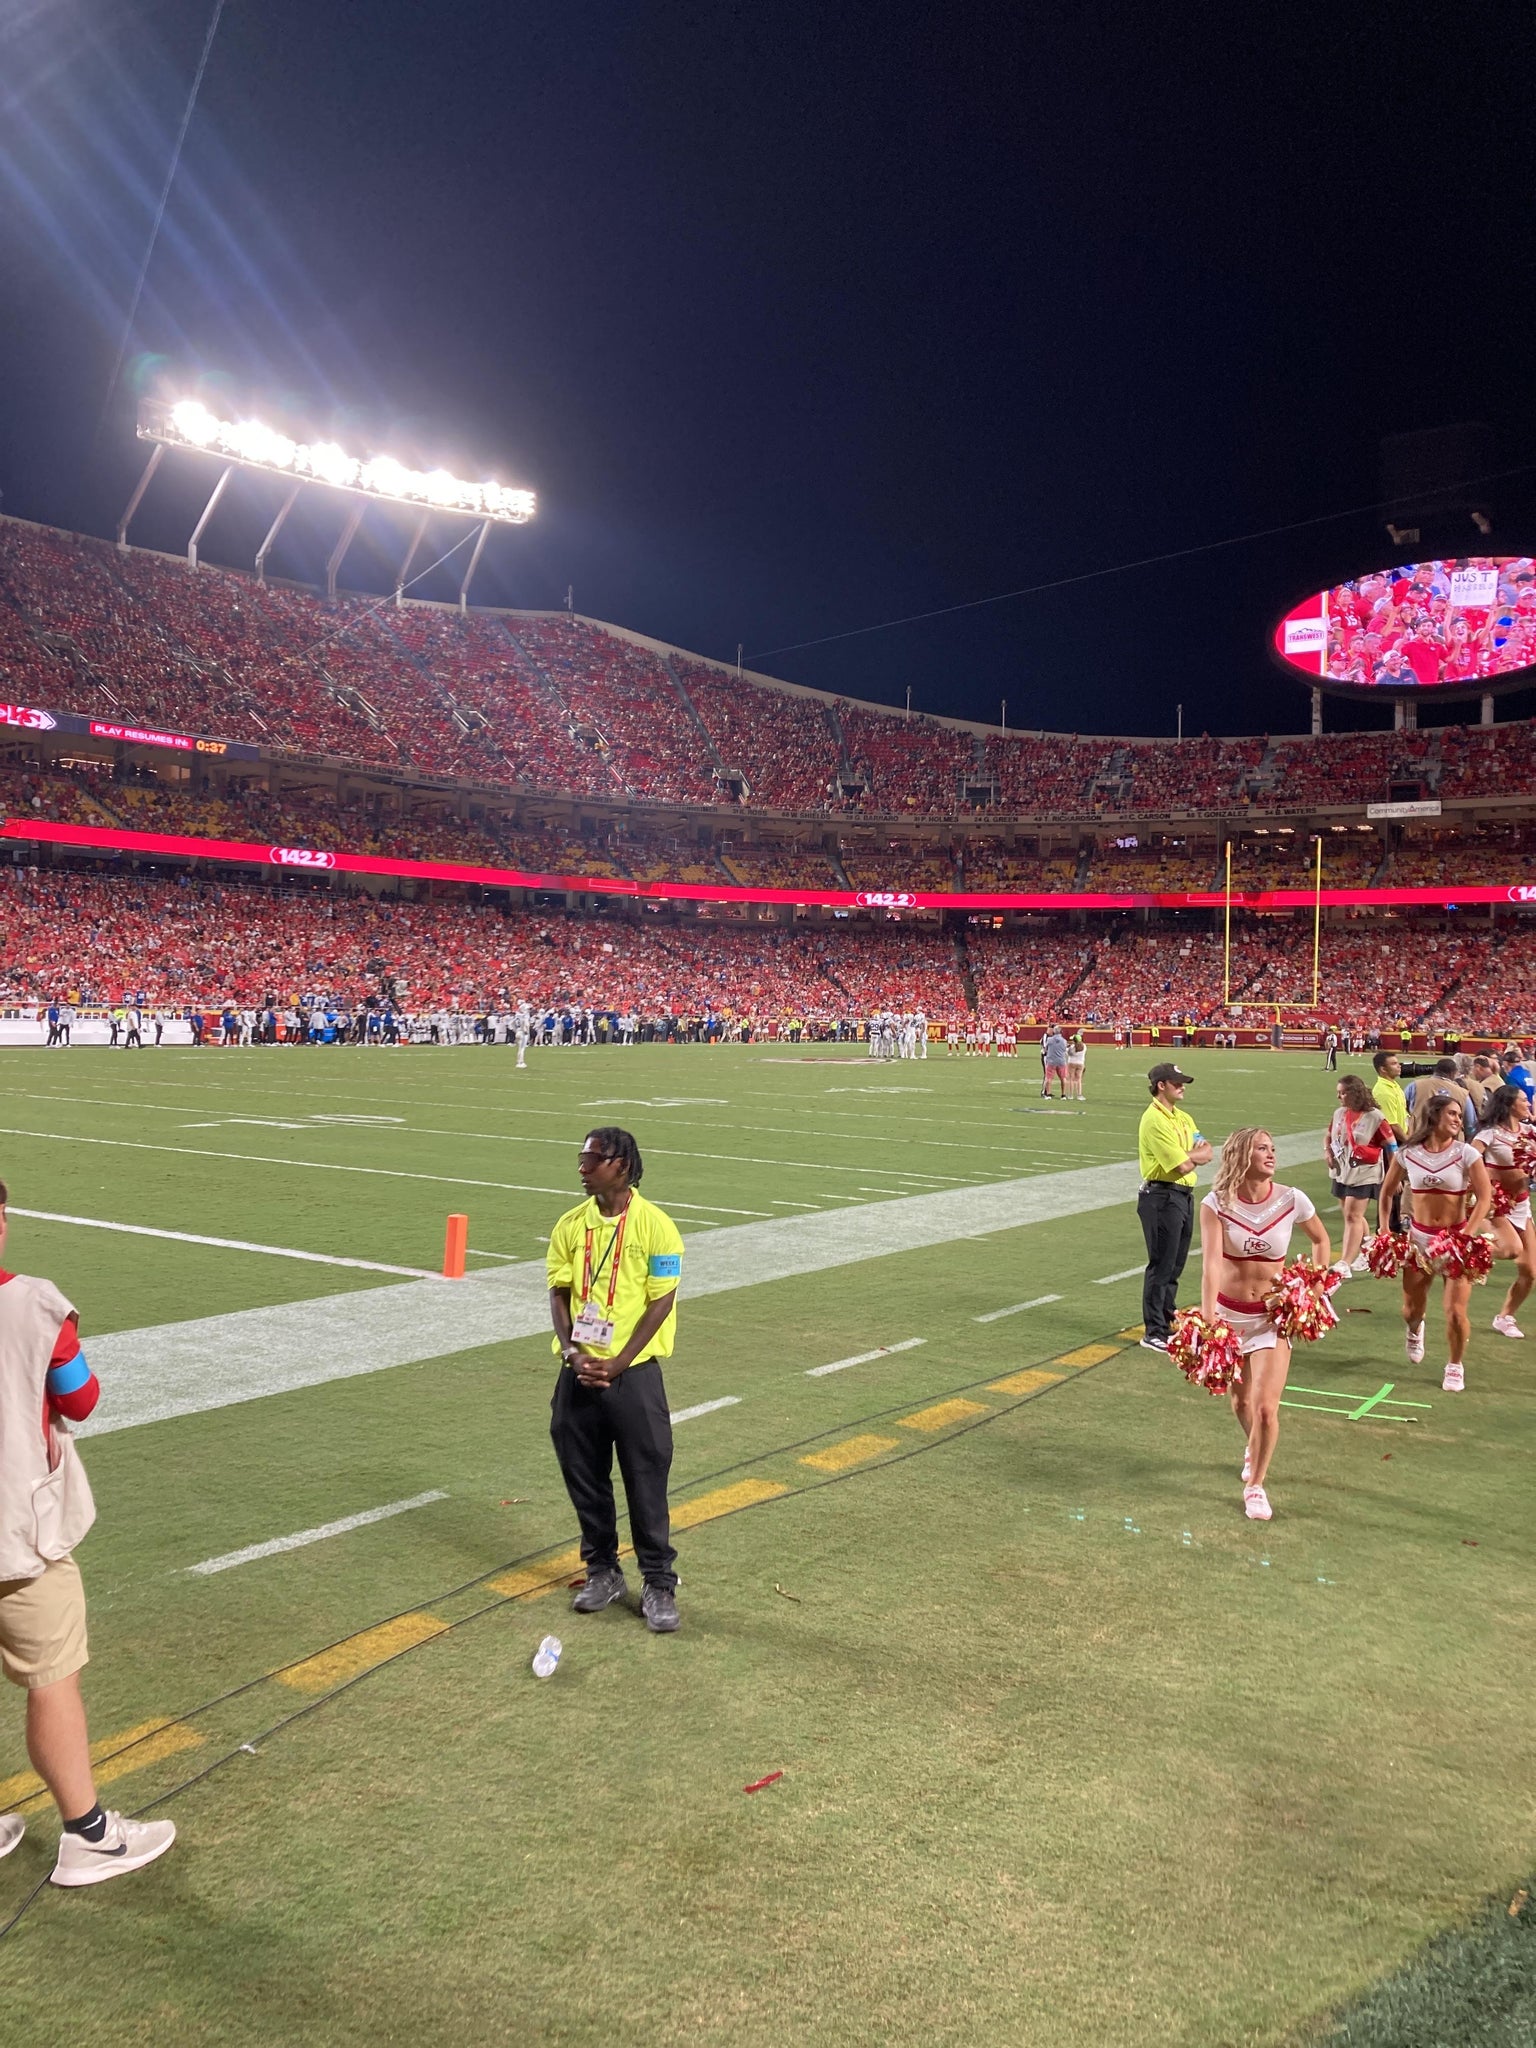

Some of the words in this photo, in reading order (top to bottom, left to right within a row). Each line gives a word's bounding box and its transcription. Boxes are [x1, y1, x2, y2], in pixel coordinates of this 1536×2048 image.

[1454, 572, 1491, 583] JUST
[1288, 632, 1323, 641] TRANSWEST
[95, 725, 122, 736] PLAY
[124, 730, 173, 744] RESUMES
[196, 740, 227, 754] 0:37
[340, 761, 361, 770] JACK
[1368, 804, 1439, 815] CommunityAmerica
[800, 812, 831, 820] SHIELDS
